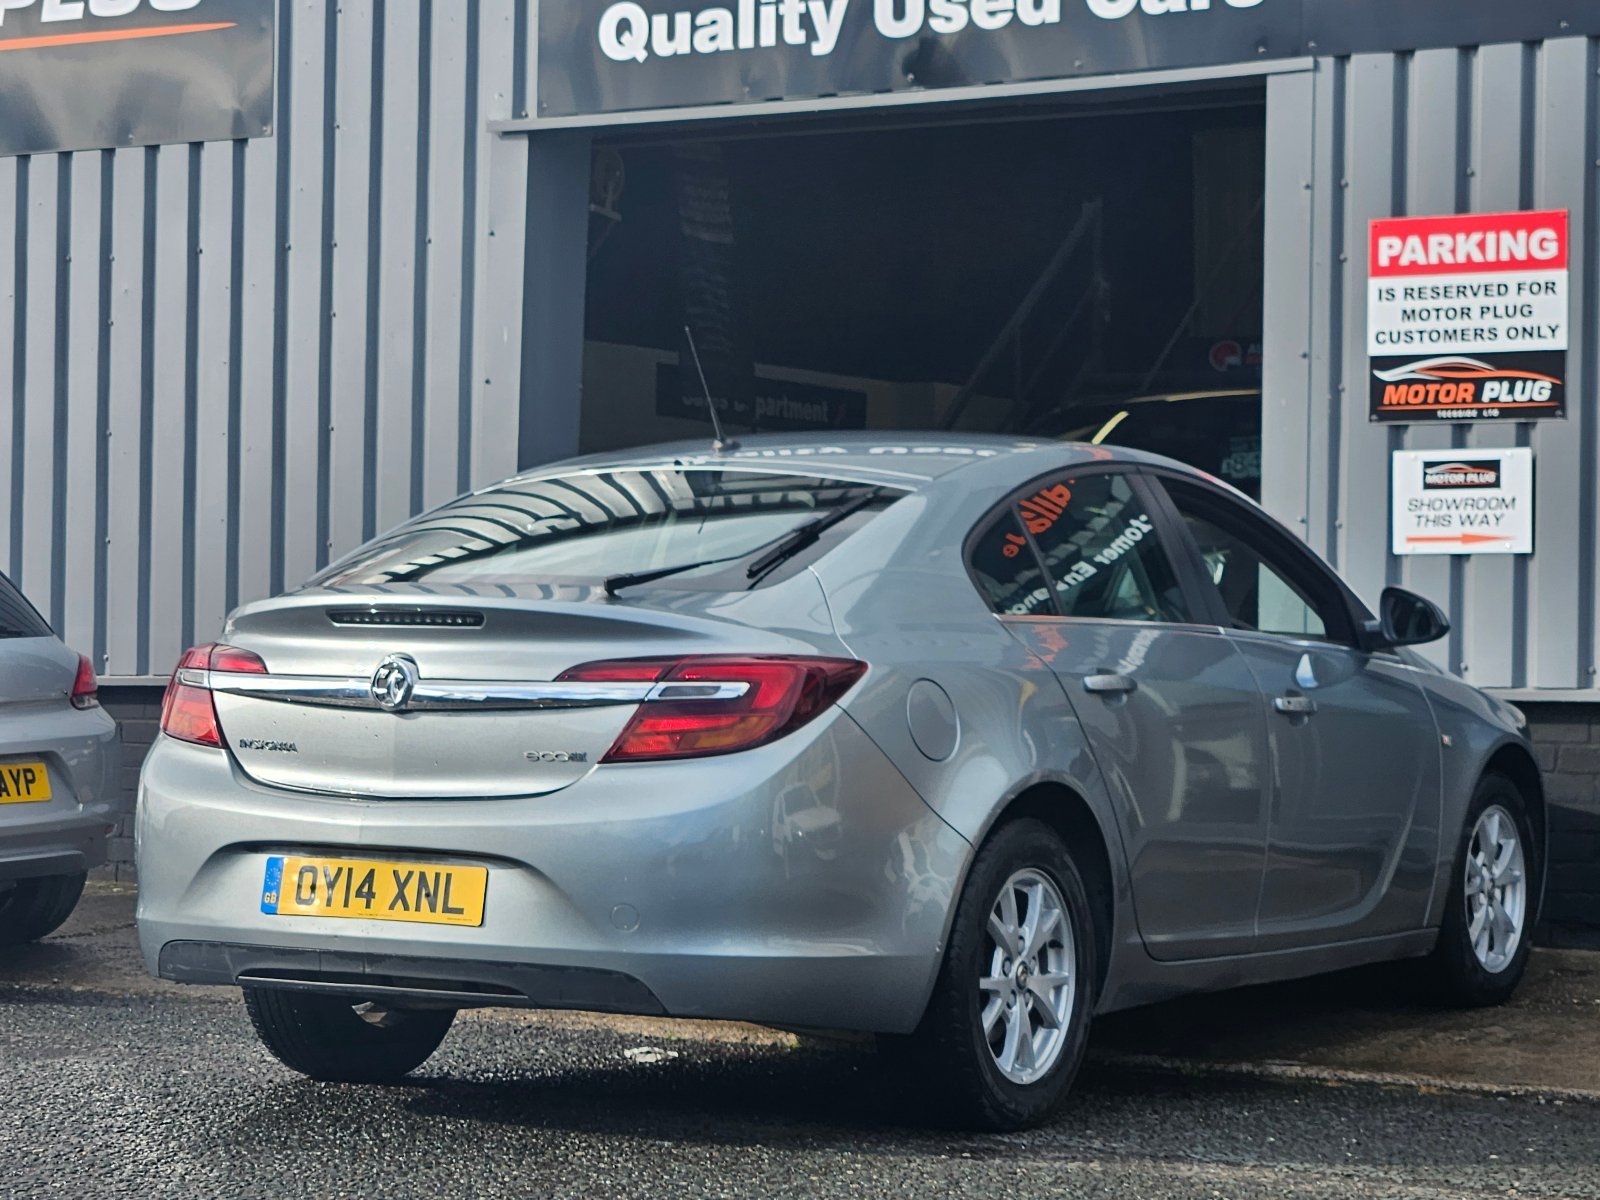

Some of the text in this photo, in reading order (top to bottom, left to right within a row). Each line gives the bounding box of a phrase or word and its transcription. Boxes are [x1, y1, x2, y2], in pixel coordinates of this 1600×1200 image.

[598, 0, 849, 63] Quality
[1378, 228, 1559, 268] PARKING
[1378, 281, 1558, 302] IS RESERVED FOR
[1401, 304, 1534, 323] MOTOR PLUG
[1375, 325, 1560, 345] CUSTOMERS ONLY
[1383, 380, 1553, 405] MOTOR PLUG
[1407, 496, 1517, 513] SHOWROOM
[1414, 513, 1505, 528] THIS WAY
[0, 767, 37, 798] AYP
[264, 891, 277, 904] GB
[295, 865, 465, 916] OY14 XNL
